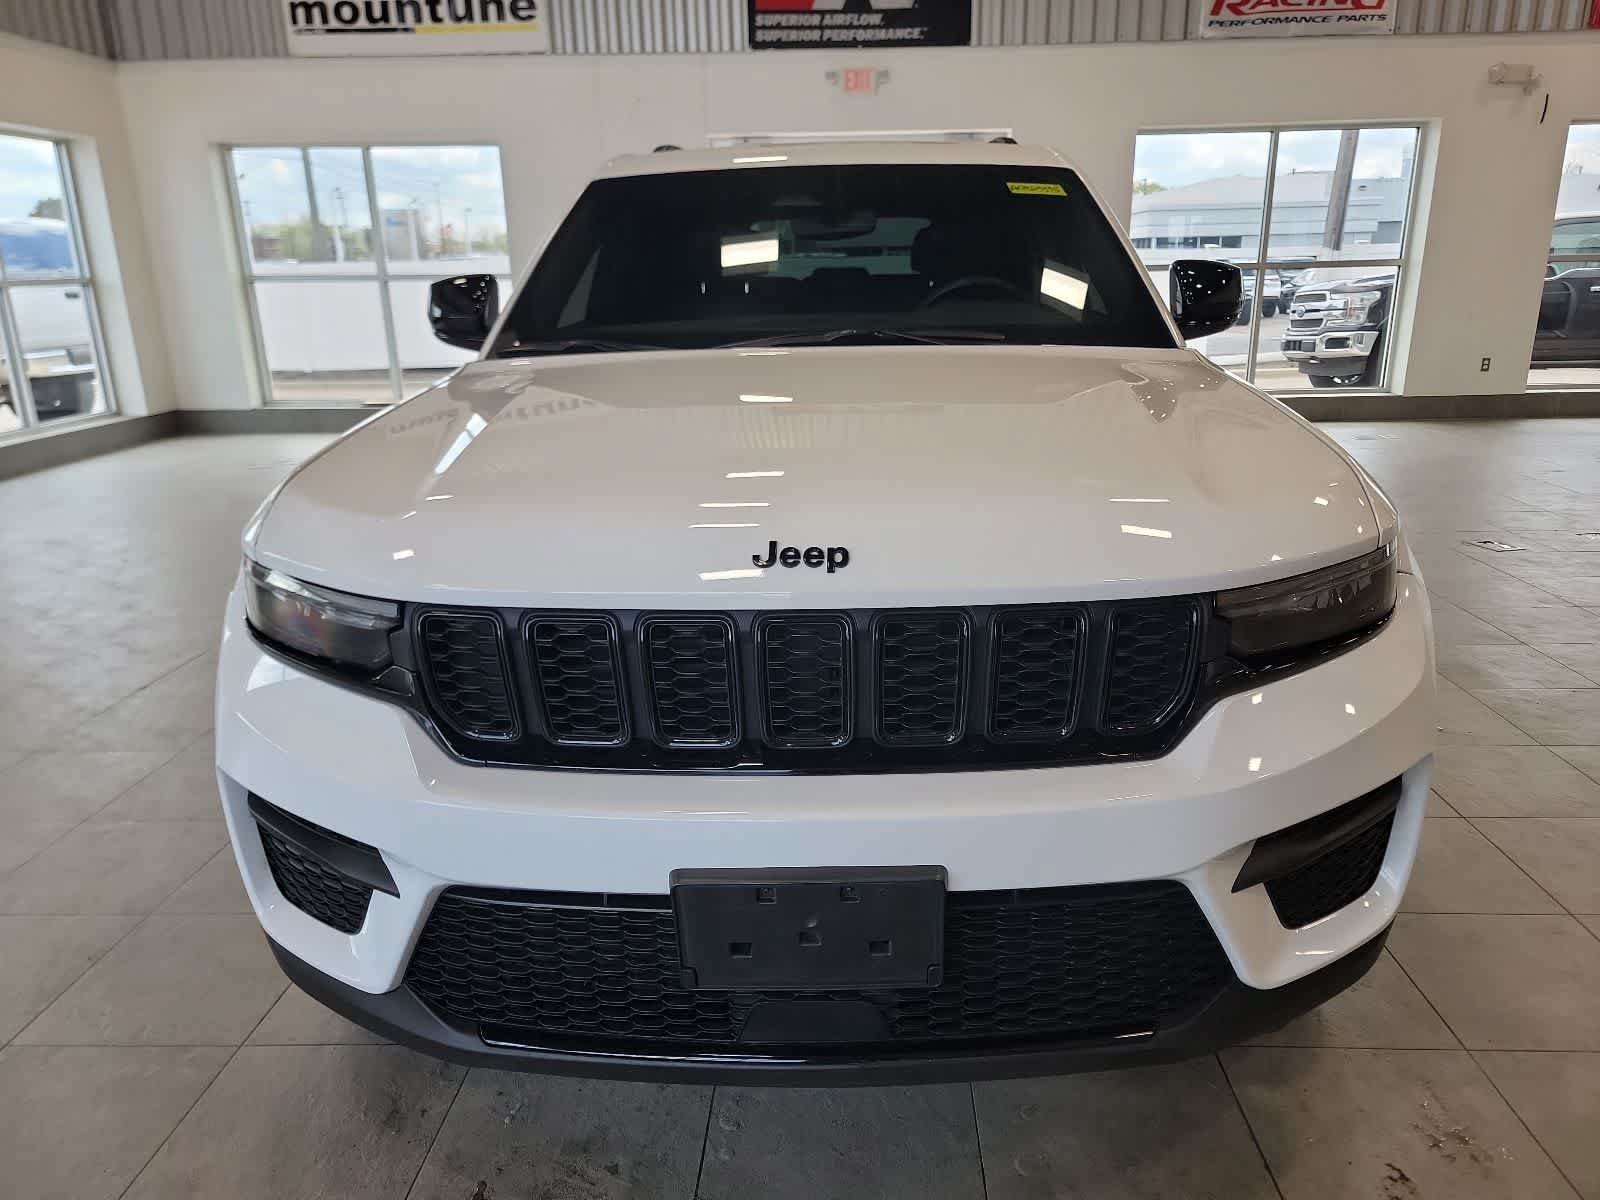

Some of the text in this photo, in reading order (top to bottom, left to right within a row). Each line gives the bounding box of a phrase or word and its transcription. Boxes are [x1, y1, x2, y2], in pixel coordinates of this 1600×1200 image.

[290, 0, 537, 25] mountune
[755, 13, 821, 26] SUPERIOR
[1208, 14, 1388, 28] PERFORMANCE PARTS
[755, 29, 821, 42] SUPERIOR
[752, 540, 850, 573] Jeep
